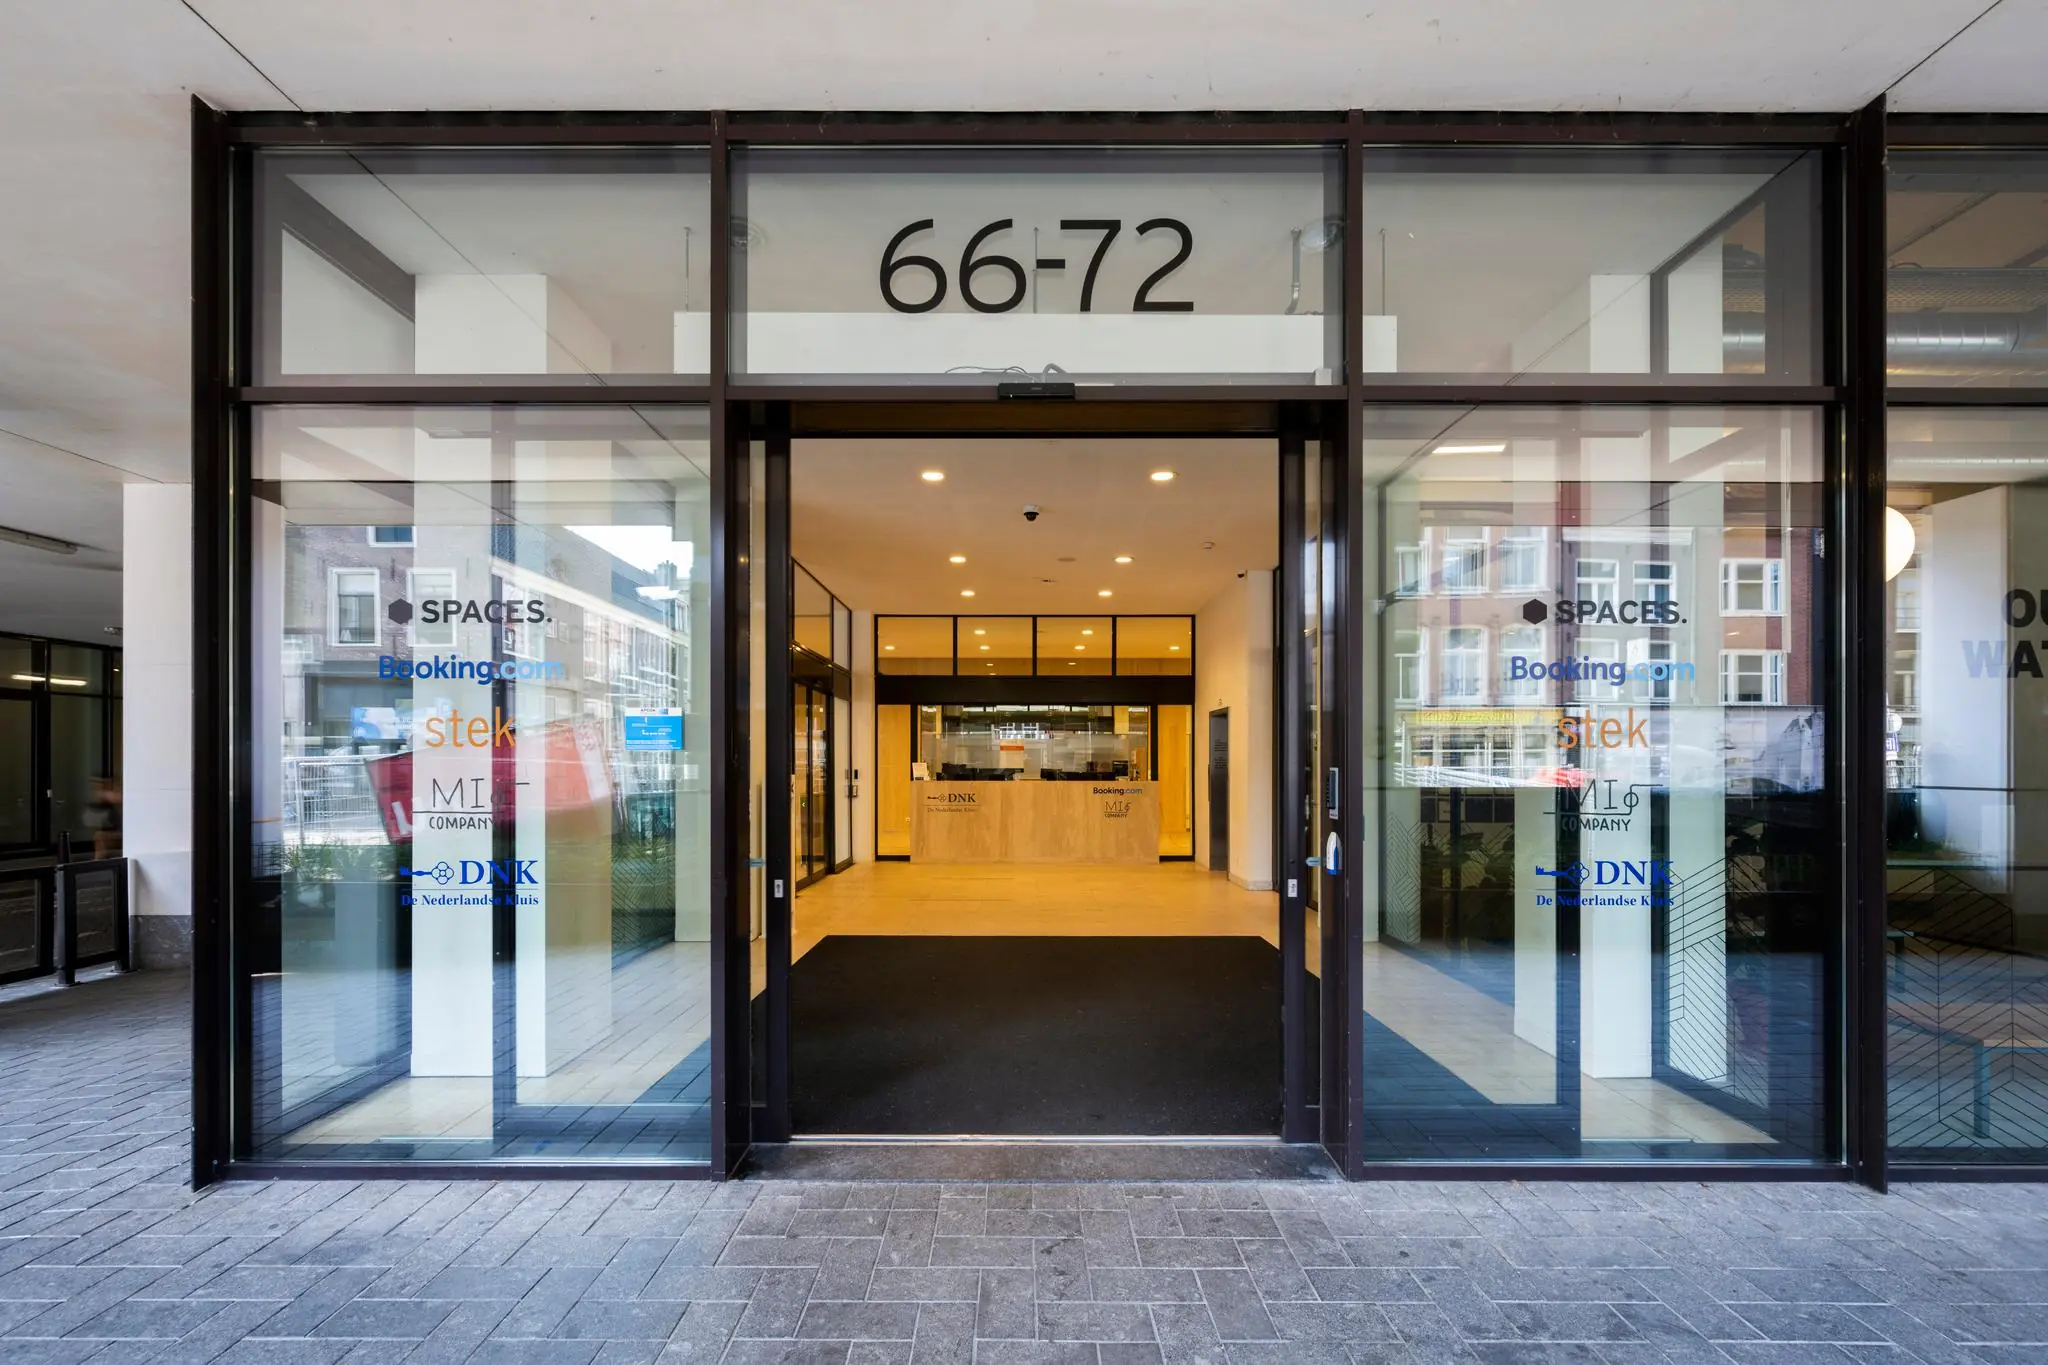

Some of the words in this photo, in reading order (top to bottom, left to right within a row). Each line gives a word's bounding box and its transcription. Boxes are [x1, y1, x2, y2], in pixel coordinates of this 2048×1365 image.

[879, 217, 1195, 314] 66-72
[421, 599, 553, 624] SPACES.
[1555, 600, 1688, 624] SPACES.
[2001, 588, 2048, 628] O
[378, 654, 565, 686] Booking.com
[1511, 655, 1696, 687] Booking.com
[1961, 640, 2048, 679] WA
[425, 706, 516, 749] stek
[1558, 707, 1650, 750] stek
[947, 793, 977, 803] DNK
[1092, 786, 1143, 796] Booking.com
[1561, 817, 1632, 832] COMPANY
[458, 860, 539, 885] DNK
[1593, 860, 1674, 885] DNK
[401, 894, 418, 906] De
[422, 893, 502, 906] Nederlandse
[505, 893, 539, 906] Kluis
[1535, 894, 1553, 906] De
[1556, 894, 1637, 906] Nederlandse
